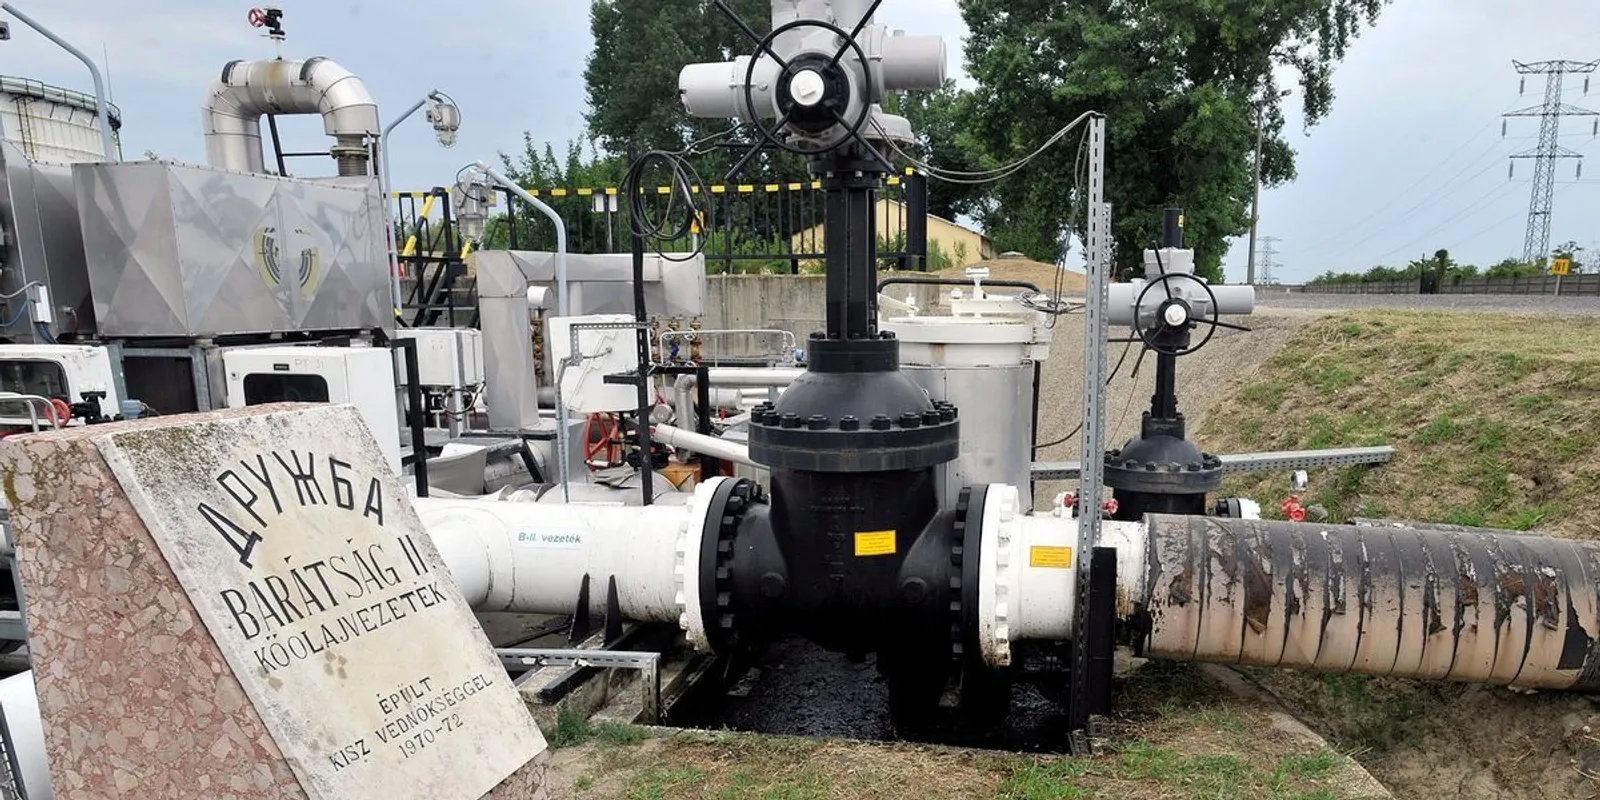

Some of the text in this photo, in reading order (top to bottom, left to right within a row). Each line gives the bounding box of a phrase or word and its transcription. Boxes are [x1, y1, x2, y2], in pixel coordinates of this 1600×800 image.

[197, 450, 384, 569] ДРУЖБА
[220, 538, 401, 640] BARÁTSÁG
[328, 674, 494, 771] KISZ VÉDNÖKSÉGGEL
[376, 676, 432, 714] ÉPÜLT
[398, 713, 464, 759] 1970-72
